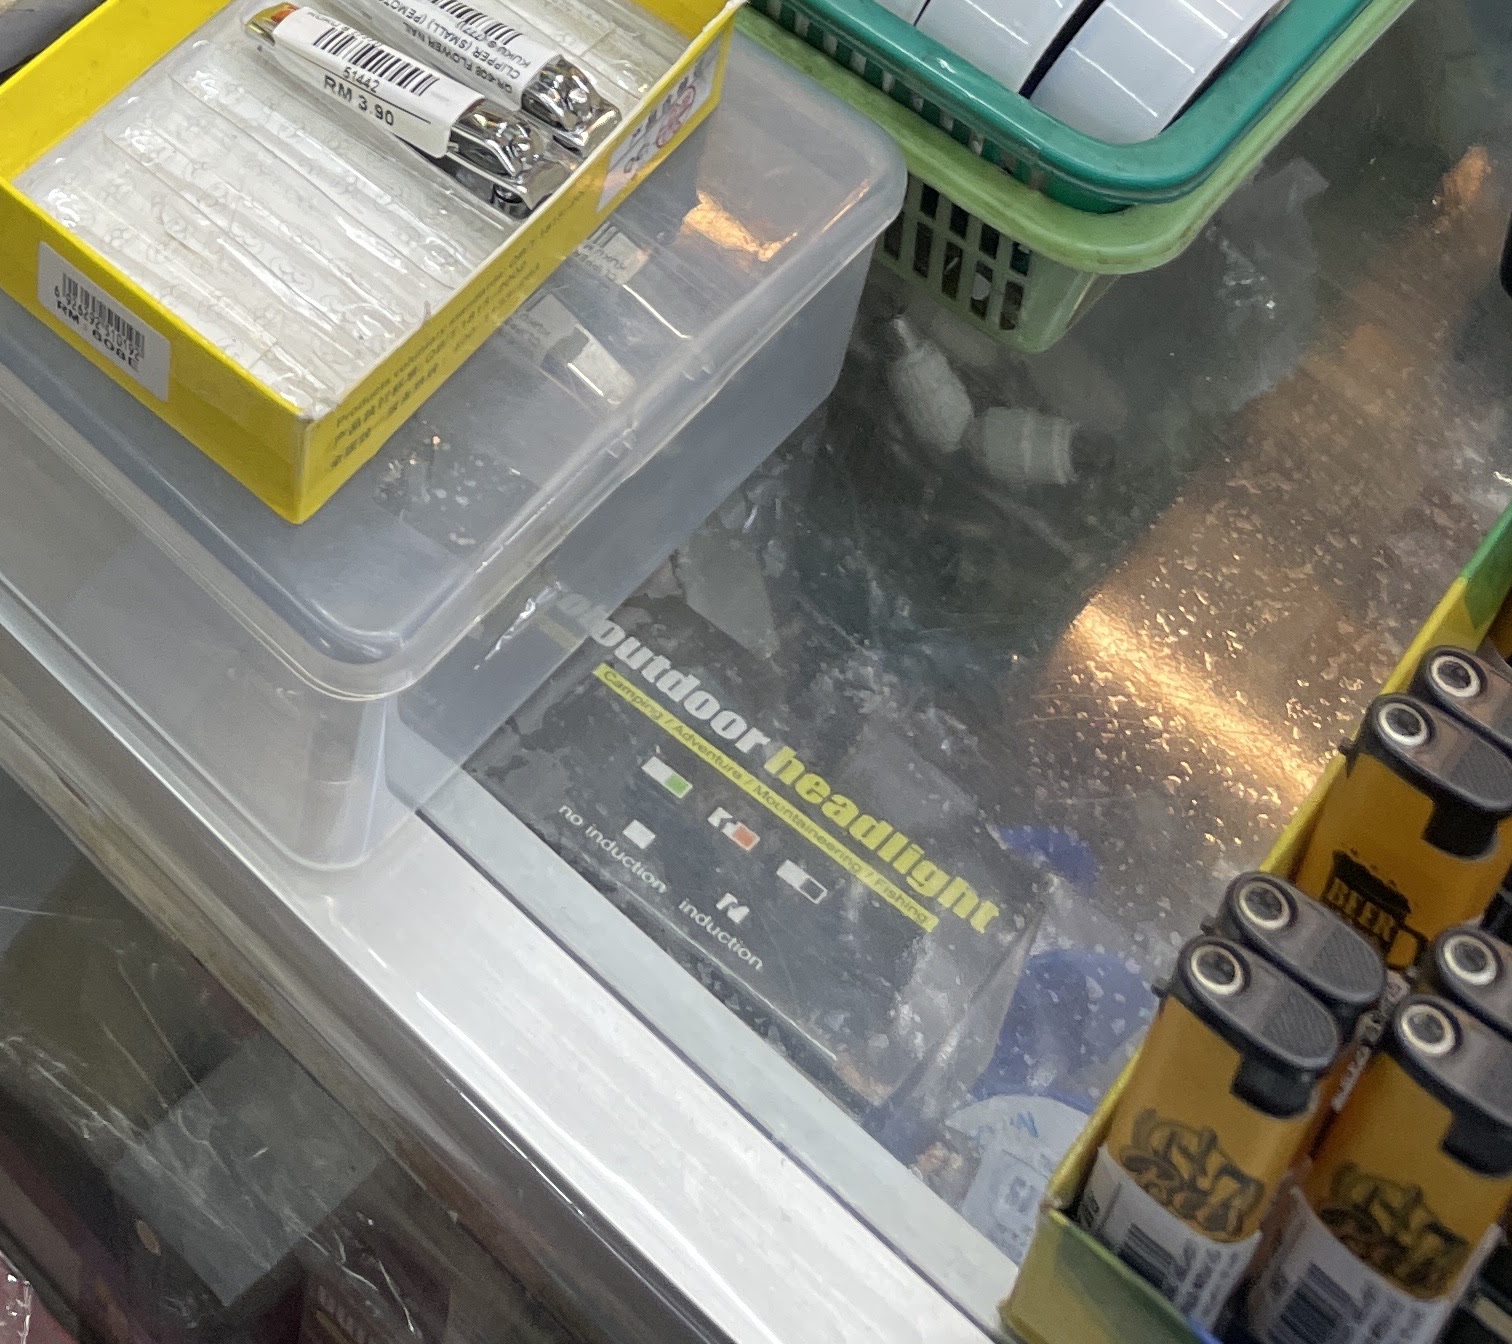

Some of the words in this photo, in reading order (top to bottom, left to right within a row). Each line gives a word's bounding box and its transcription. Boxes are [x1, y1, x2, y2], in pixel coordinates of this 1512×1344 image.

[426, 18, 473, 58] (SMALL)
[473, 45, 523, 81] CLIPPER
[323, 74, 353, 103] RM
[357, 91, 395, 127] 3.90
[341, 65, 381, 95] 51442
[56, 299, 80, 325] RM
[590, 617, 771, 753] outdoor
[763, 745, 1000, 933] headlight
[602, 668, 665, 722] Camping
[753, 782, 864, 874] Mountaineering
[872, 876, 931, 925] Fishing
[558, 804, 583, 828] no
[585, 822, 667, 895] induction
[677, 897, 765, 972] induction
